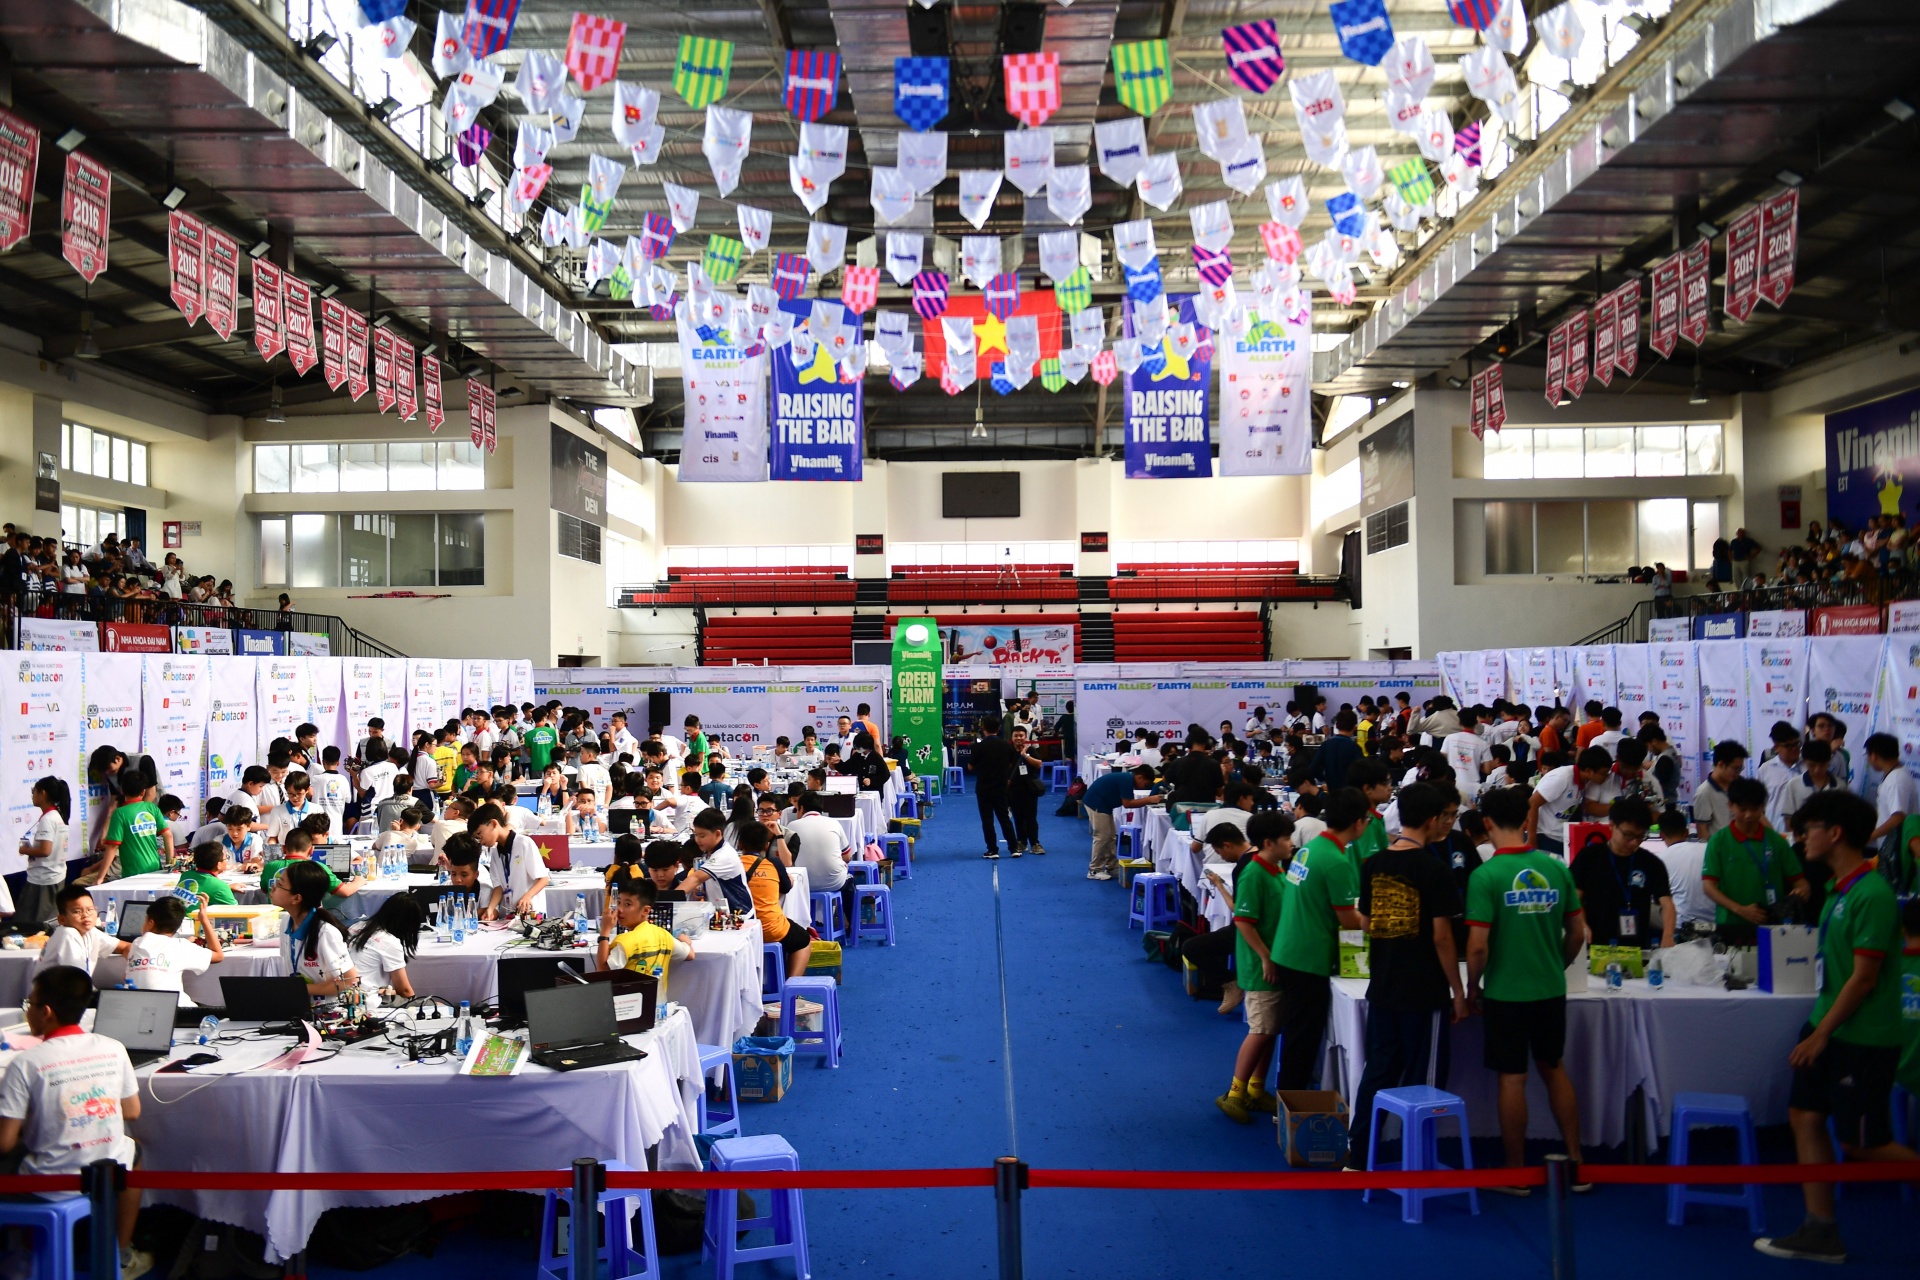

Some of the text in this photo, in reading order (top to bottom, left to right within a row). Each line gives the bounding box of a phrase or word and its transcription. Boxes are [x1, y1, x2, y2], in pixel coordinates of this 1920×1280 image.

[681, 61, 723, 80] Vinamilk
[788, 75, 833, 94] Vinamilk
[899, 83, 944, 101] Vinamilk
[1305, 98, 1334, 117] cis
[1397, 103, 1423, 121] cis
[0, 159, 24, 195] 016
[73, 197, 100, 231] 2016
[1769, 229, 1792, 260] 2019
[177, 250, 198, 279] 2016
[1734, 250, 1756, 280] 2019
[212, 269, 231, 297] 2016
[1688, 276, 1707, 300] 2019
[258, 295, 276, 320] 2017
[752, 303, 769, 315] cis
[289, 312, 307, 335] 2017
[325, 332, 341, 353] 2017
[1236, 340, 1295, 353] EARTH
[1248, 354, 1284, 362] ALLIES
[375, 357, 389, 378] 2017
[426, 381, 438, 400] 2017
[779, 392, 854, 418] RAISING
[1131, 389, 1204, 416] RAISING
[704, 430, 739, 442] Vinamilk
[776, 419, 856, 444] THE BAR
[1130, 417, 1204, 443] THE BAR
[1248, 424, 1282, 434] Vinamilk
[1836, 409, 1920, 474] Vinami
[584, 450, 598, 472] THE
[703, 454, 719, 463] cis
[790, 454, 843, 469] Vinamilk
[1144, 452, 1195, 467] Vinamilk
[1246, 450, 1262, 458] cis
[1838, 476, 1849, 493] EST
[584, 496, 599, 516] DEN
[1703, 618, 1736, 637] Vinamilk
[20, 640, 66, 651] Robotacon
[121, 636, 167, 646] NHA KHOA NAM
[243, 635, 274, 653] Vinamilk
[902, 650, 932, 661] Vinamilk
[19, 671, 63, 683] Robotacon
[163, 671, 196, 682] Robotacon
[898, 672, 936, 687] GREEN
[1157, 682, 1191, 690] EARTH
[1231, 681, 1264, 689] EARTH
[1340, 680, 1374, 688] ALLIES
[586, 687, 620, 695] EARTH
[660, 686, 693, 694] EARTH
[694, 686, 727, 694] ALLIES
[767, 685, 801, 693] ALLIES
[806, 685, 839, 693] EARTH
[900, 688, 934, 703] FARM
[1825, 700, 1870, 715] Robotaco
[87, 717, 133, 729] Robotacon
[211, 711, 248, 722] Robotacon
[684, 732, 760, 742] Rbtacon
[1106, 728, 1182, 740] Robcon
[78, 753, 86, 784] ALLIES
[210, 769, 228, 781] RTH
[88, 785, 109, 797] RTH
[79, 789, 87, 822] EARTH
[130, 821, 157, 834] EARTH
[1504, 888, 1559, 907] EARTH
[60, 1059, 76, 1067] STEM
[77, 1055, 106, 1064] ROBOTICS
[50, 1075, 90, 1087] ROBOTACON
[1309, 1118, 1334, 1132] ICY
